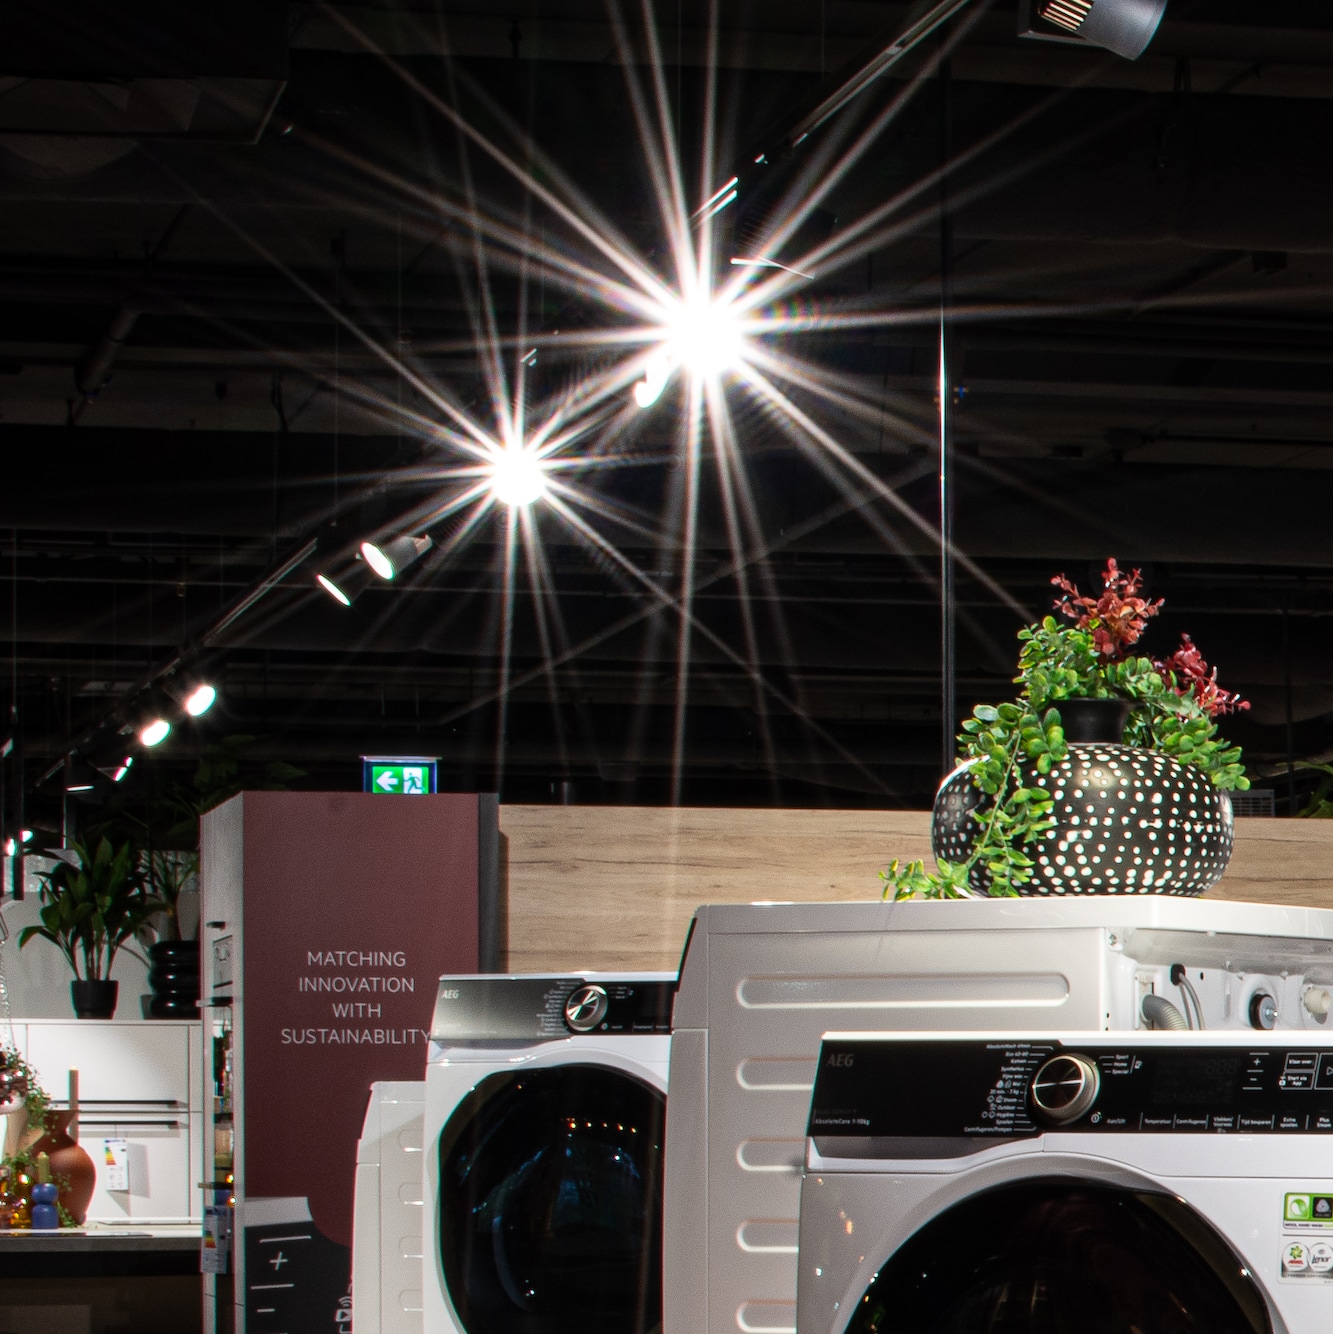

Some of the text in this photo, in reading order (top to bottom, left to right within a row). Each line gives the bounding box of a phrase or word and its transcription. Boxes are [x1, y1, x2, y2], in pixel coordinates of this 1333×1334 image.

[307, 951, 407, 967] MATCHING
[299, 977, 415, 993] INNOVATION
[442, 989, 460, 999] AEG
[332, 1003, 382, 1018] WITH
[281, 1028, 431, 1044] SUSTAINABILITY
[827, 1053, 854, 1067] AEG
